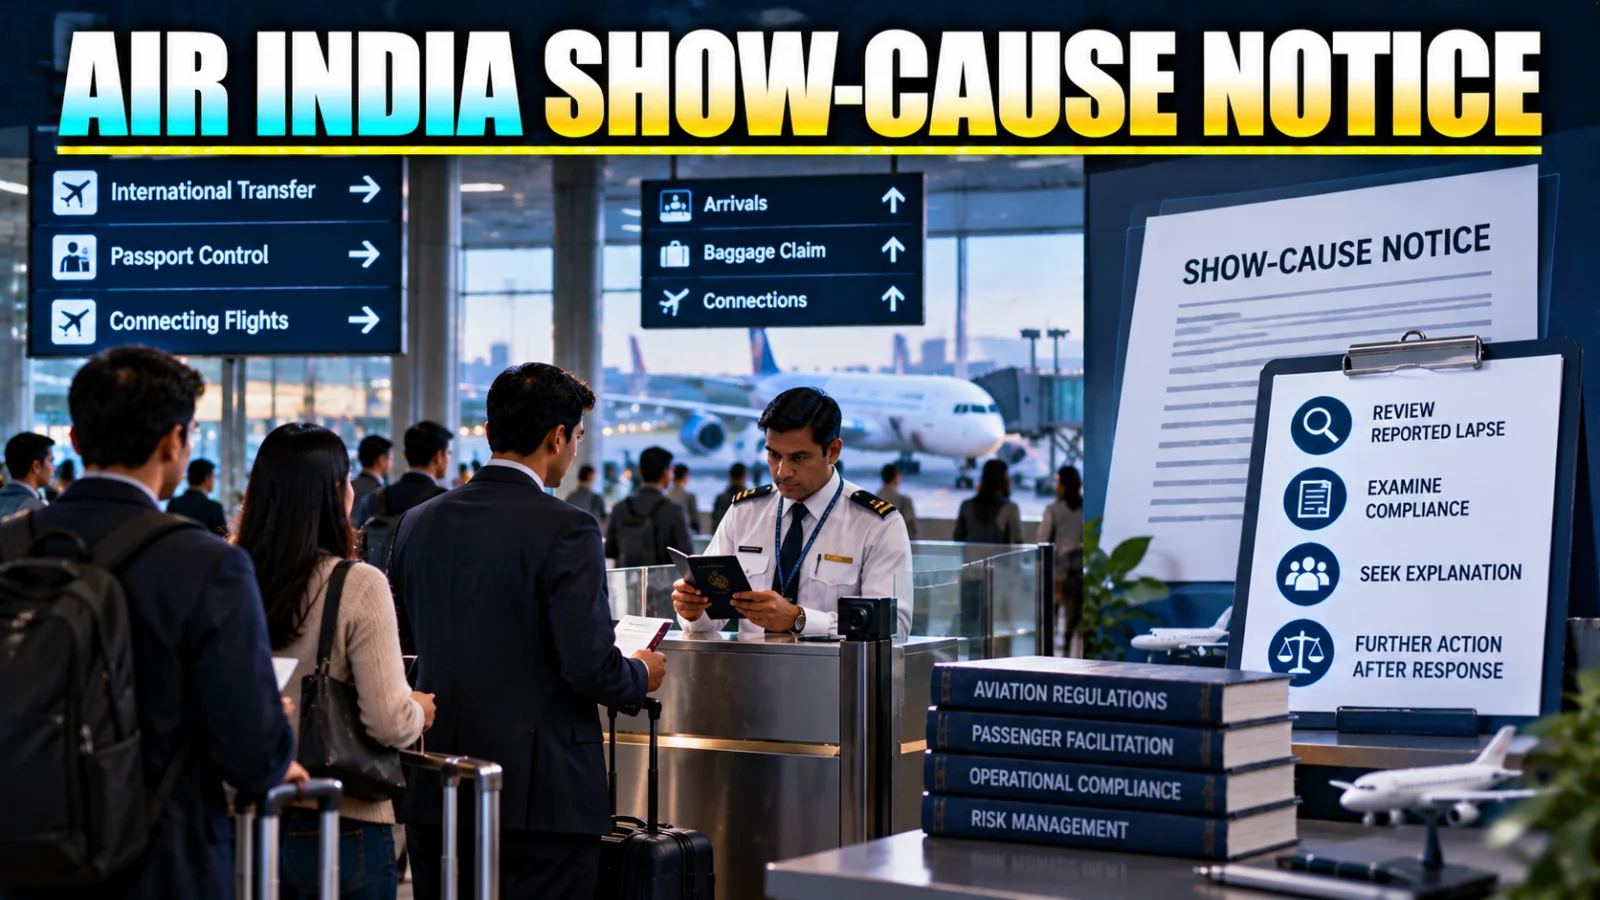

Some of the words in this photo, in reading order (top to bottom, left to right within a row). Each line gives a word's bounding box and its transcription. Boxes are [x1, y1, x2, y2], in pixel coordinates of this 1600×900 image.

[111, 179, 232, 201] International
[237, 178, 317, 200] Transfer
[703, 194, 768, 212] Arrivals
[111, 246, 194, 270] Passport
[198, 244, 269, 265] Control
[704, 244, 775, 264] Baggage
[779, 241, 826, 259] Claim
[1182, 237, 1373, 285] SHOW-CAUSE
[1382, 222, 1491, 263] NOTICE
[703, 290, 808, 310] Connections
[109, 309, 219, 335] Connecting
[225, 309, 289, 335] Flights
[1373, 401, 1436, 421] REVIEW
[1371, 423, 1452, 443] REPORTED
[1455, 420, 1506, 439] LAPSE
[1367, 477, 1442, 496] EXAMINE
[1365, 500, 1470, 519] COMPLIANCE
[1359, 565, 1402, 582] SEEK
[1406, 563, 1522, 582] EXPLANATION
[1355, 635, 1433, 653] FURTHER
[1436, 635, 1502, 653] ACTION
[1352, 660, 1407, 679] AFTER
[1412, 661, 1504, 680] RESPONSE
[973, 680, 1048, 702] AVIATION
[1052, 684, 1168, 711] REGULATIONS
[972, 724, 1062, 748] PASSENGER
[1066, 730, 1174, 756] FACILITATION
[969, 767, 1074, 792] OPERATIONAL
[1077, 774, 1182, 801] COMPLIANCE
[971, 809, 1007, 829] RISK
[1011, 812, 1129, 840] MANAGEMENT
